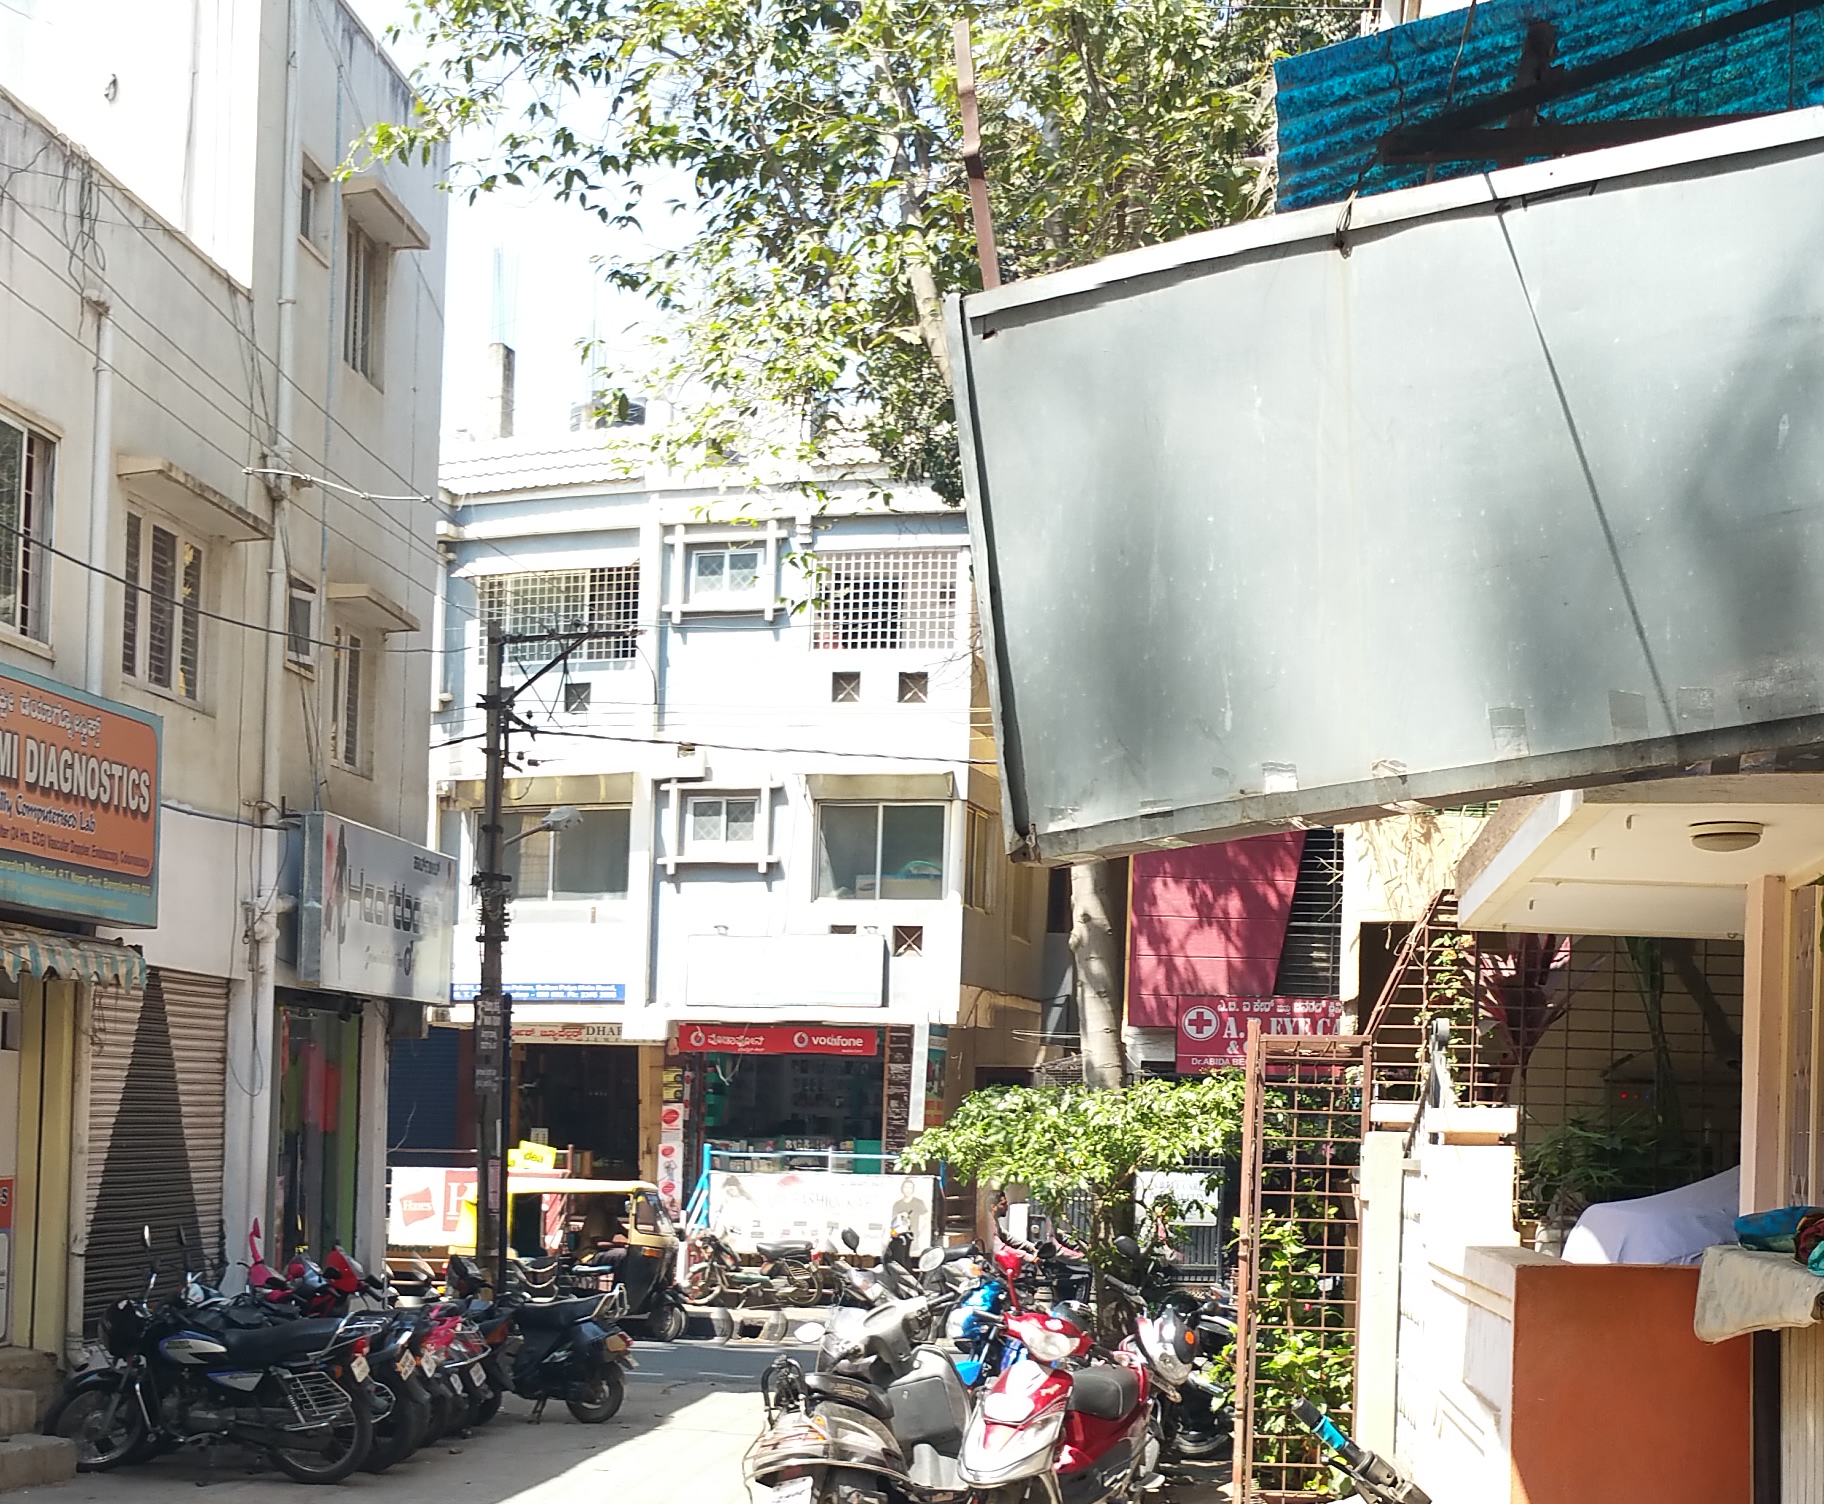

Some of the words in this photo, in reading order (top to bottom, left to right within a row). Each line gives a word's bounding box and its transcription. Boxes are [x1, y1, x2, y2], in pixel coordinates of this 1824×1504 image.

[24, 735, 150, 814] DIAGNOSTICS
[79, 811, 96, 834] Lab
[1270, 1016, 1311, 1036] EYE
[811, 1034, 864, 1047] vodafone
